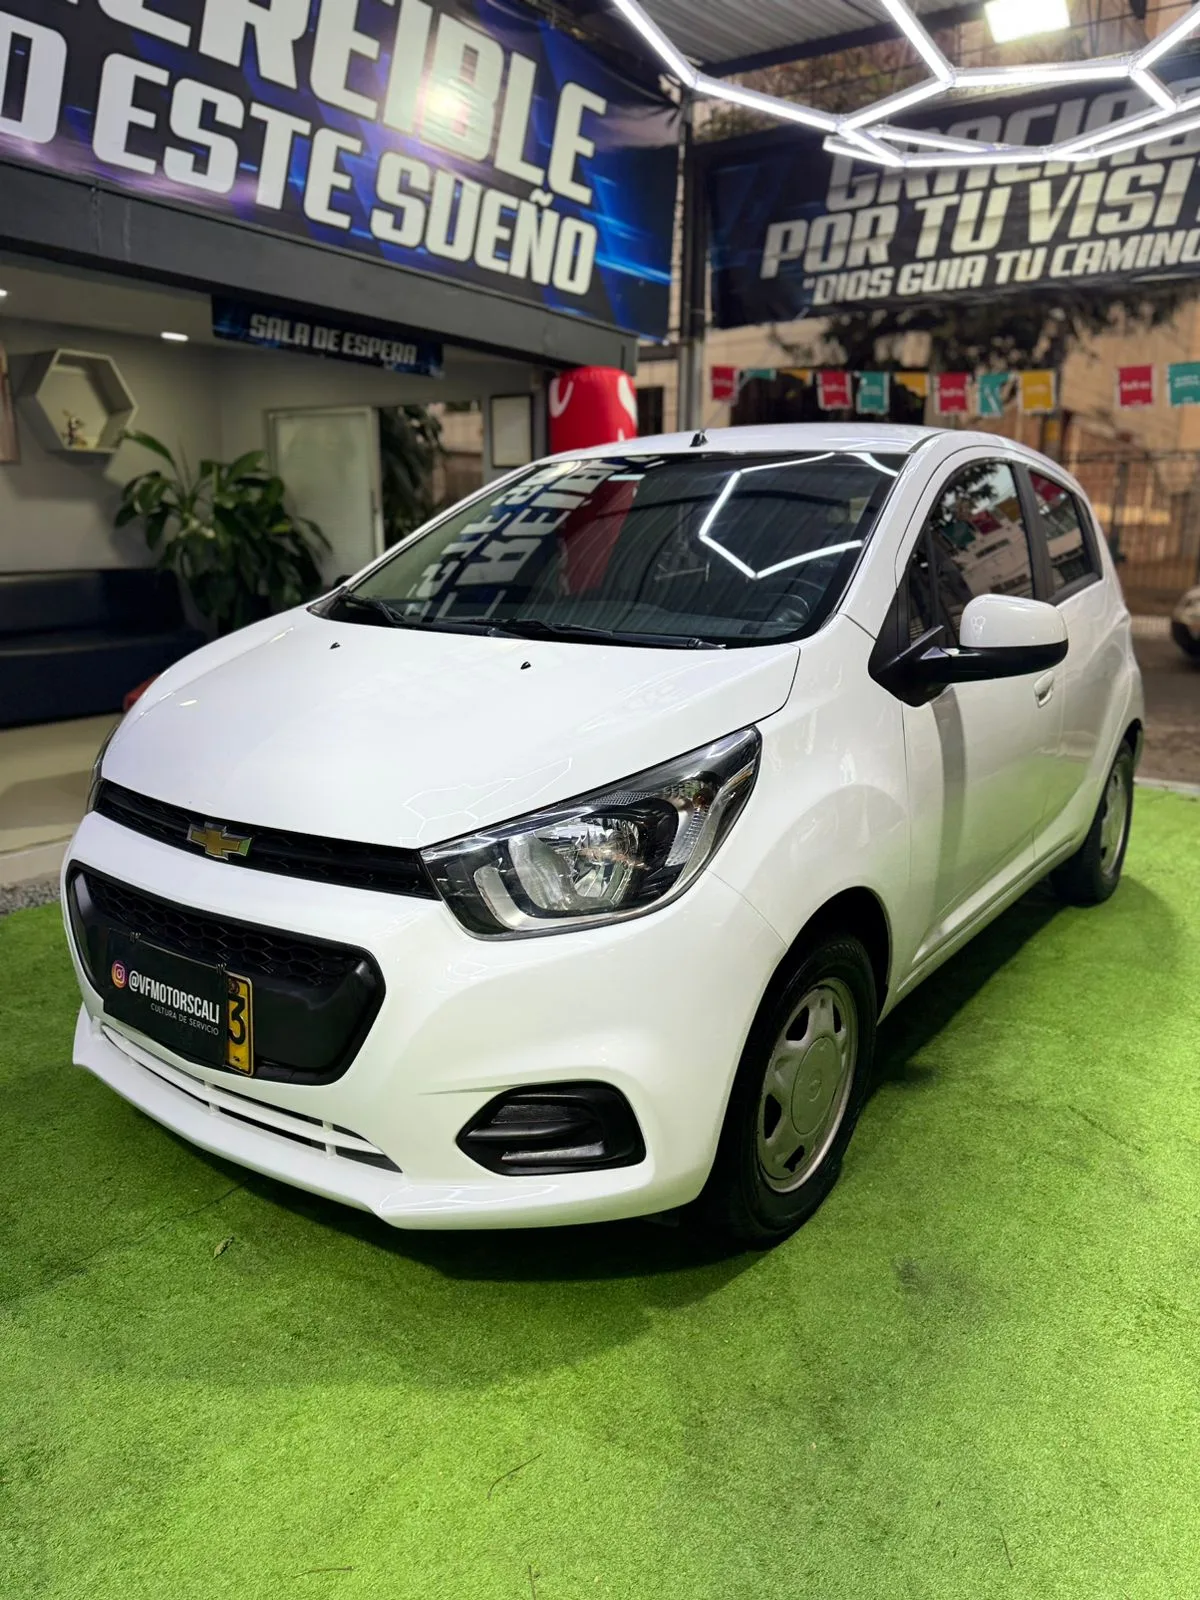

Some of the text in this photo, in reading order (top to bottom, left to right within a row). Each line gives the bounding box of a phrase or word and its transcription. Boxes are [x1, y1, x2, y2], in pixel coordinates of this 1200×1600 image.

[93, 53, 362, 229] ESTE
[371, 151, 597, 295] SUEÑO
[760, 156, 1200, 279] POR TU VISI
[897, 254, 988, 296] GUIA
[995, 247, 1047, 285] TU
[250, 313, 418, 365] SALA DE ESPERA
[129, 970, 220, 1025] @VFMOTORSCALI
[151, 1002, 219, 1036] CULTURA DE SERVICIO
